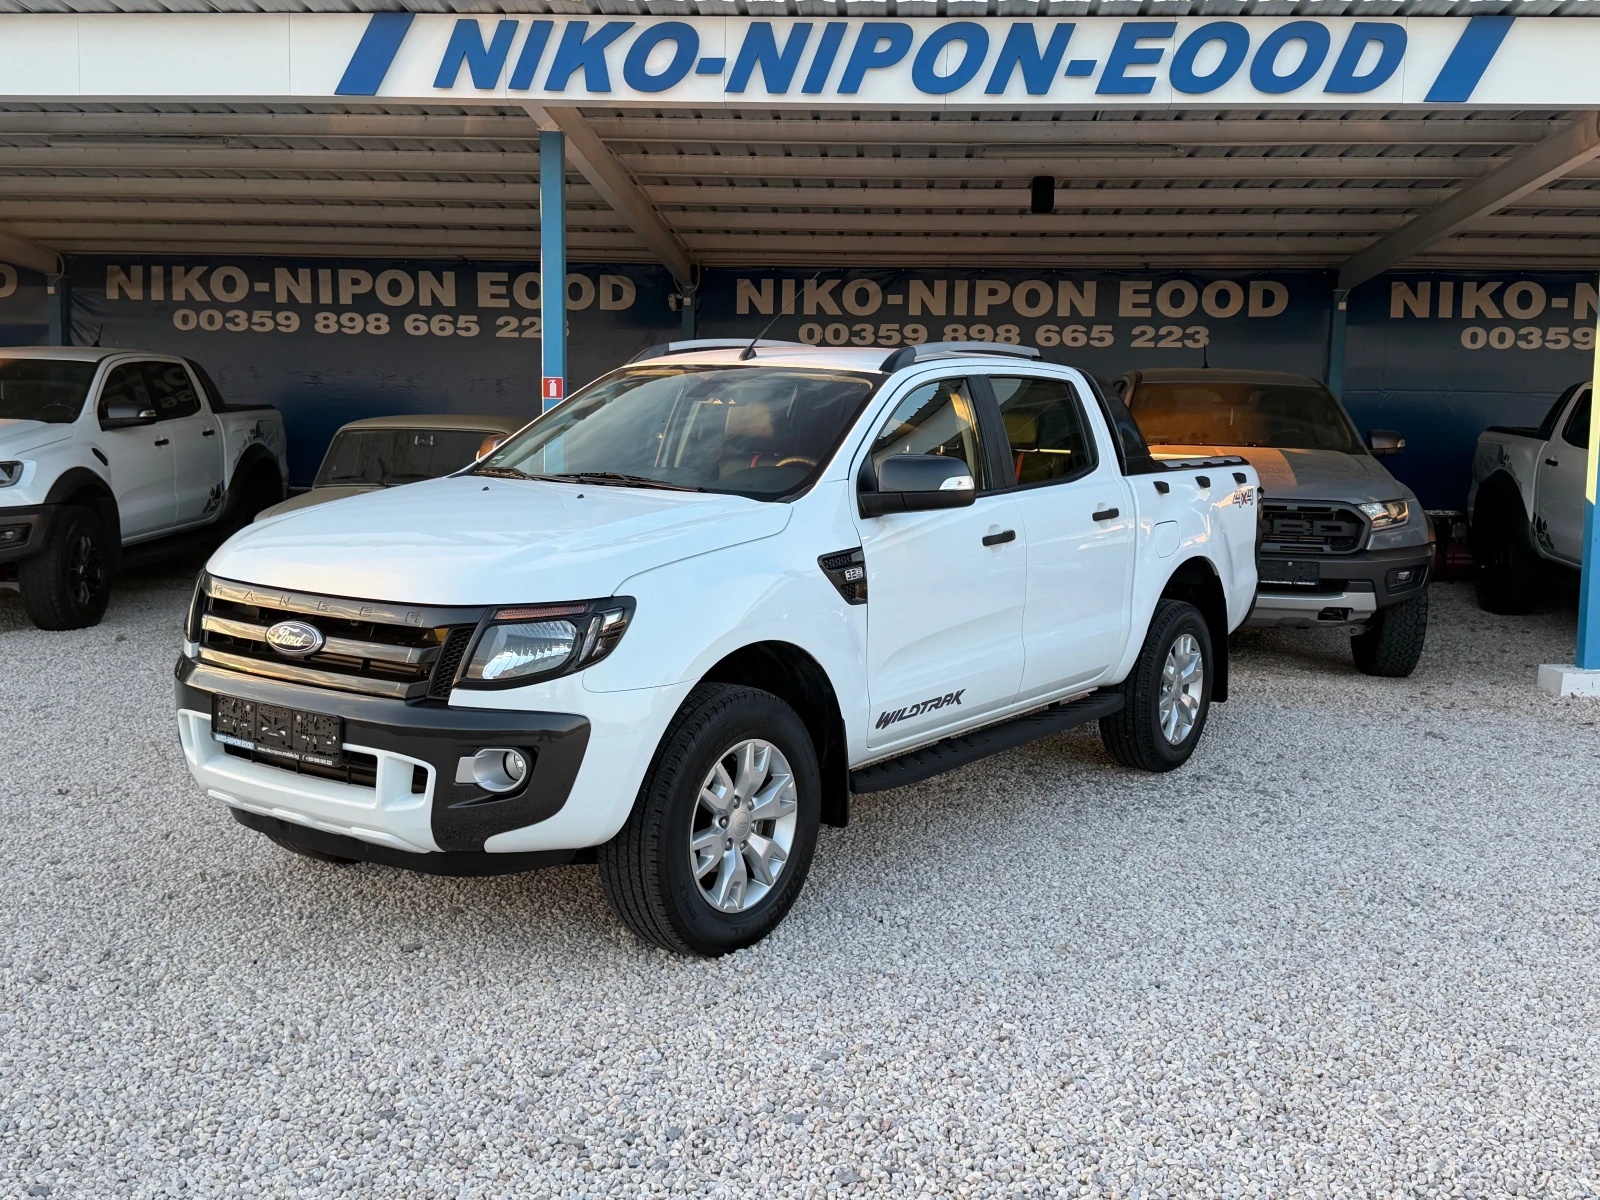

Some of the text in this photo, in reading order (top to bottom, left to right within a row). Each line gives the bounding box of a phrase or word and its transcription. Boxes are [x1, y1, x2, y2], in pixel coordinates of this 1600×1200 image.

[434, 20, 1408, 95] NIKO-NIPON-EOOD
[105, 264, 637, 311] NIKO-NIPON EOOD
[736, 278, 1289, 319] NIKO-NIPON EOOD
[172, 308, 570, 339] 00359 898 665 22
[798, 322, 1210, 349] 00359 898 665 223
[1461, 326, 1596, 351] 00359
[213, 583, 422, 623] RANGER
[274, 625, 305, 648] Ford
[875, 688, 967, 730] WILDTRAK
